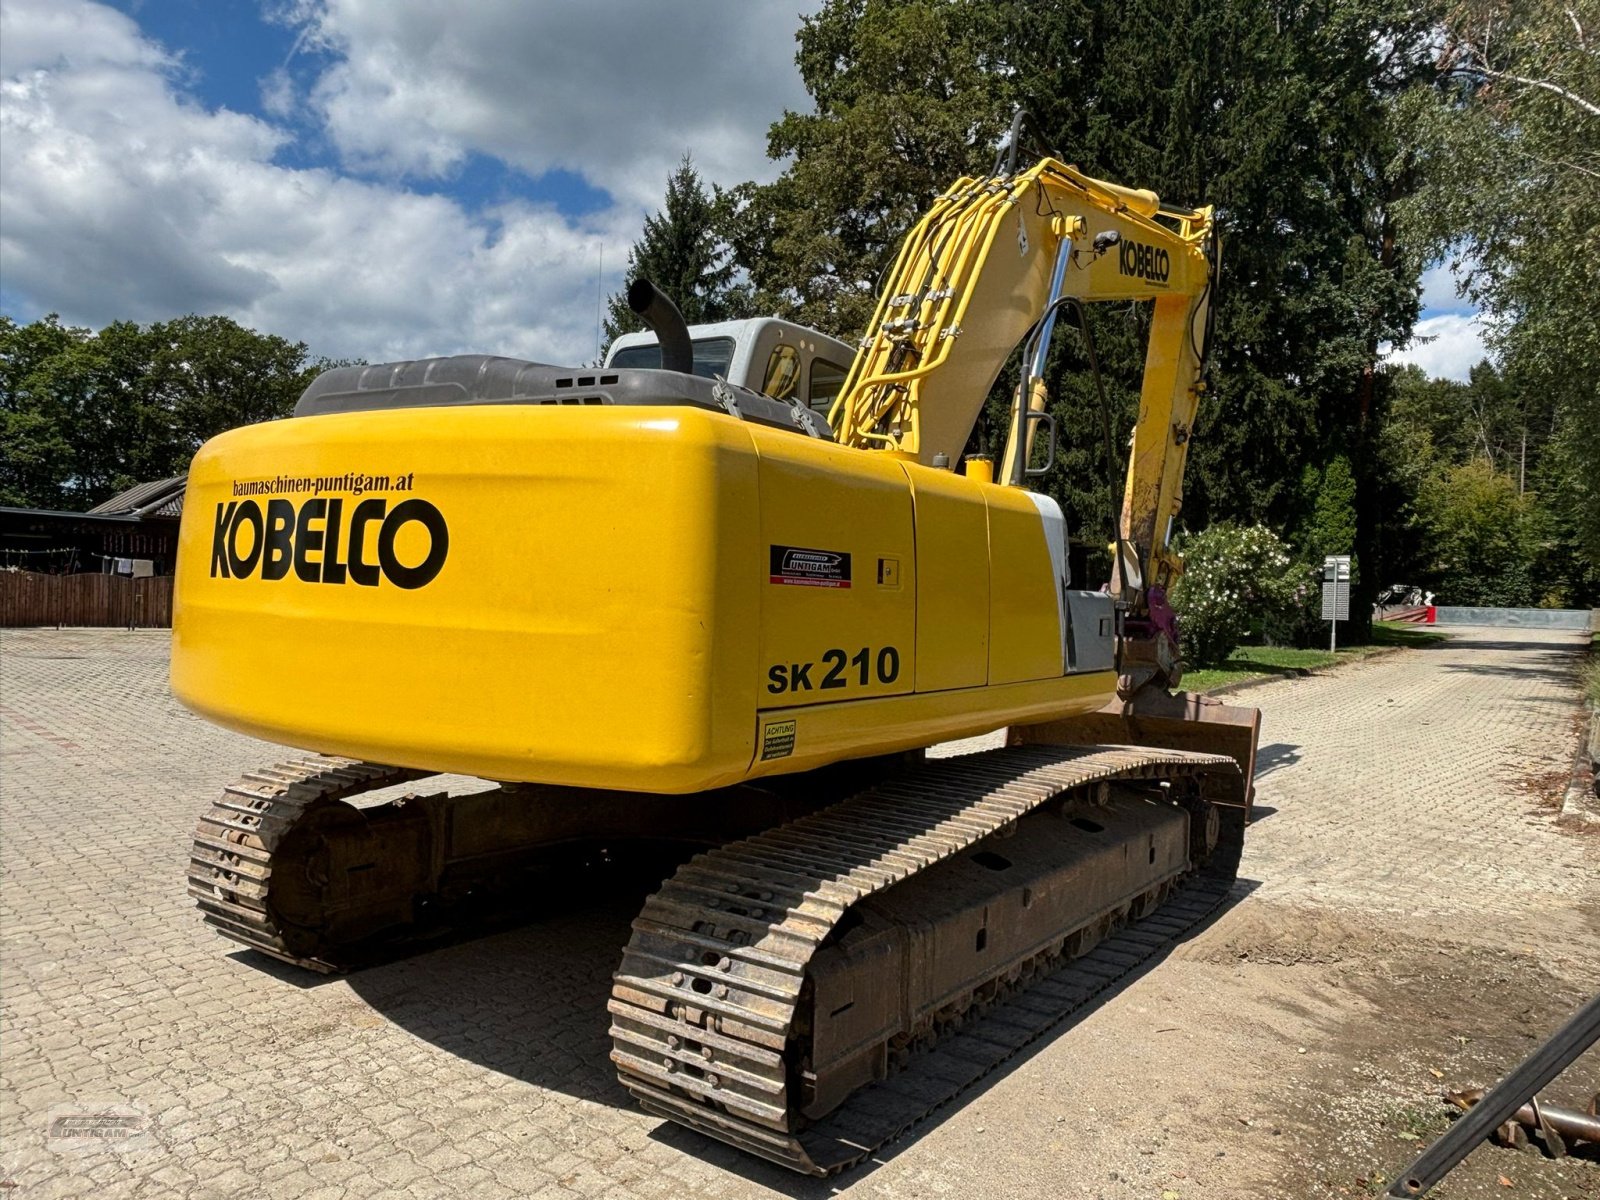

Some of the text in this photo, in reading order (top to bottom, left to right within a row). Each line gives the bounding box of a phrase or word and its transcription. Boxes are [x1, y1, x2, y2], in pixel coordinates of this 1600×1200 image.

[1119, 239, 1170, 283] KOBELCO
[233, 472, 415, 497] baumaschinen-puntigam.at
[210, 498, 449, 590] KOBELCO
[767, 646, 900, 694] SK 210
[766, 724, 794, 736] ACHTUNG
